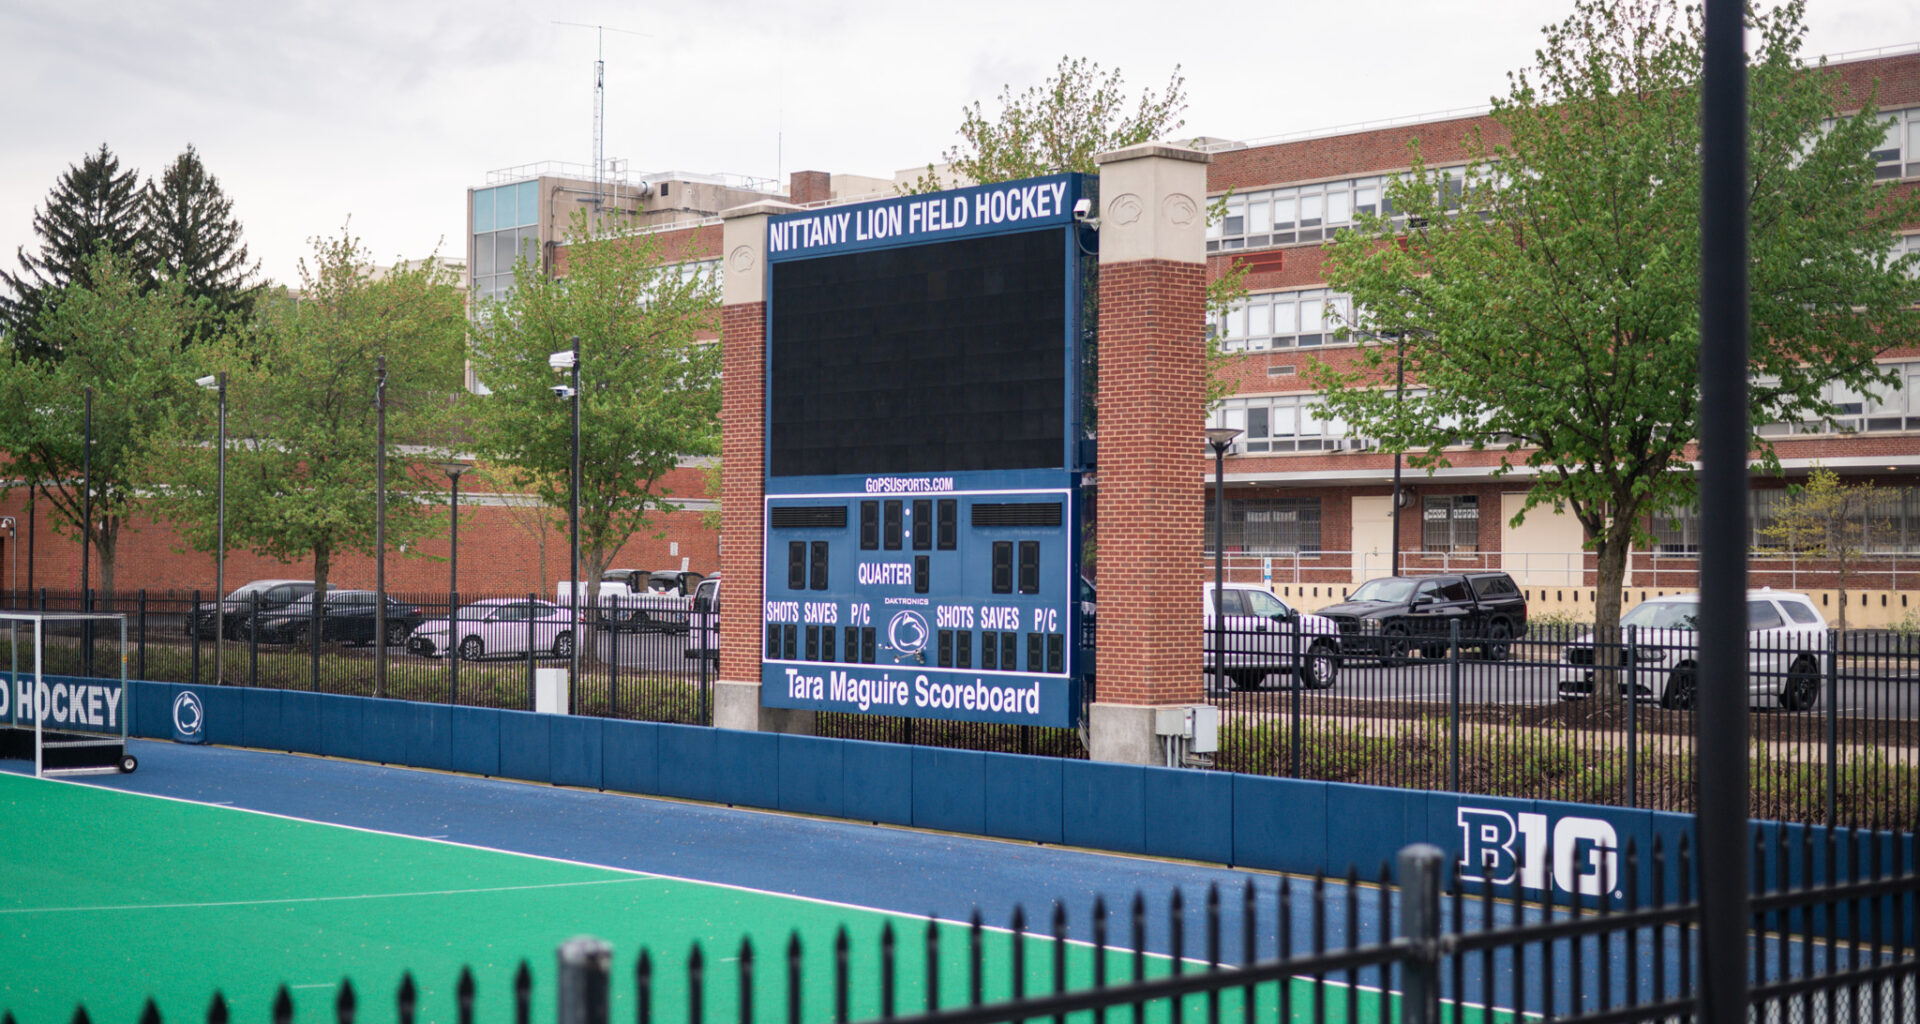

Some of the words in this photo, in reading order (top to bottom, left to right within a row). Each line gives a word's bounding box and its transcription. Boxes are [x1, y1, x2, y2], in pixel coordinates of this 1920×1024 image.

[771, 213, 851, 252] NITTANY
[856, 205, 903, 241] LION
[909, 196, 969, 234] FIELD
[975, 182, 1067, 225] HOCKEY
[858, 562, 912, 585] QUARTER
[767, 601, 799, 623] SHOTS
[804, 602, 837, 624] SAVES
[851, 603, 870, 626] P/C
[884, 597, 929, 605] DAKTRONICS
[936, 605, 974, 628] SHOTS
[980, 606, 1019, 630] SAVES
[1034, 608, 1057, 632] P/C
[17, 681, 122, 727] HOCKEY
[785, 668, 823, 700] Tara
[830, 670, 908, 711] Maguire
[915, 674, 1040, 714] Scoreboard
